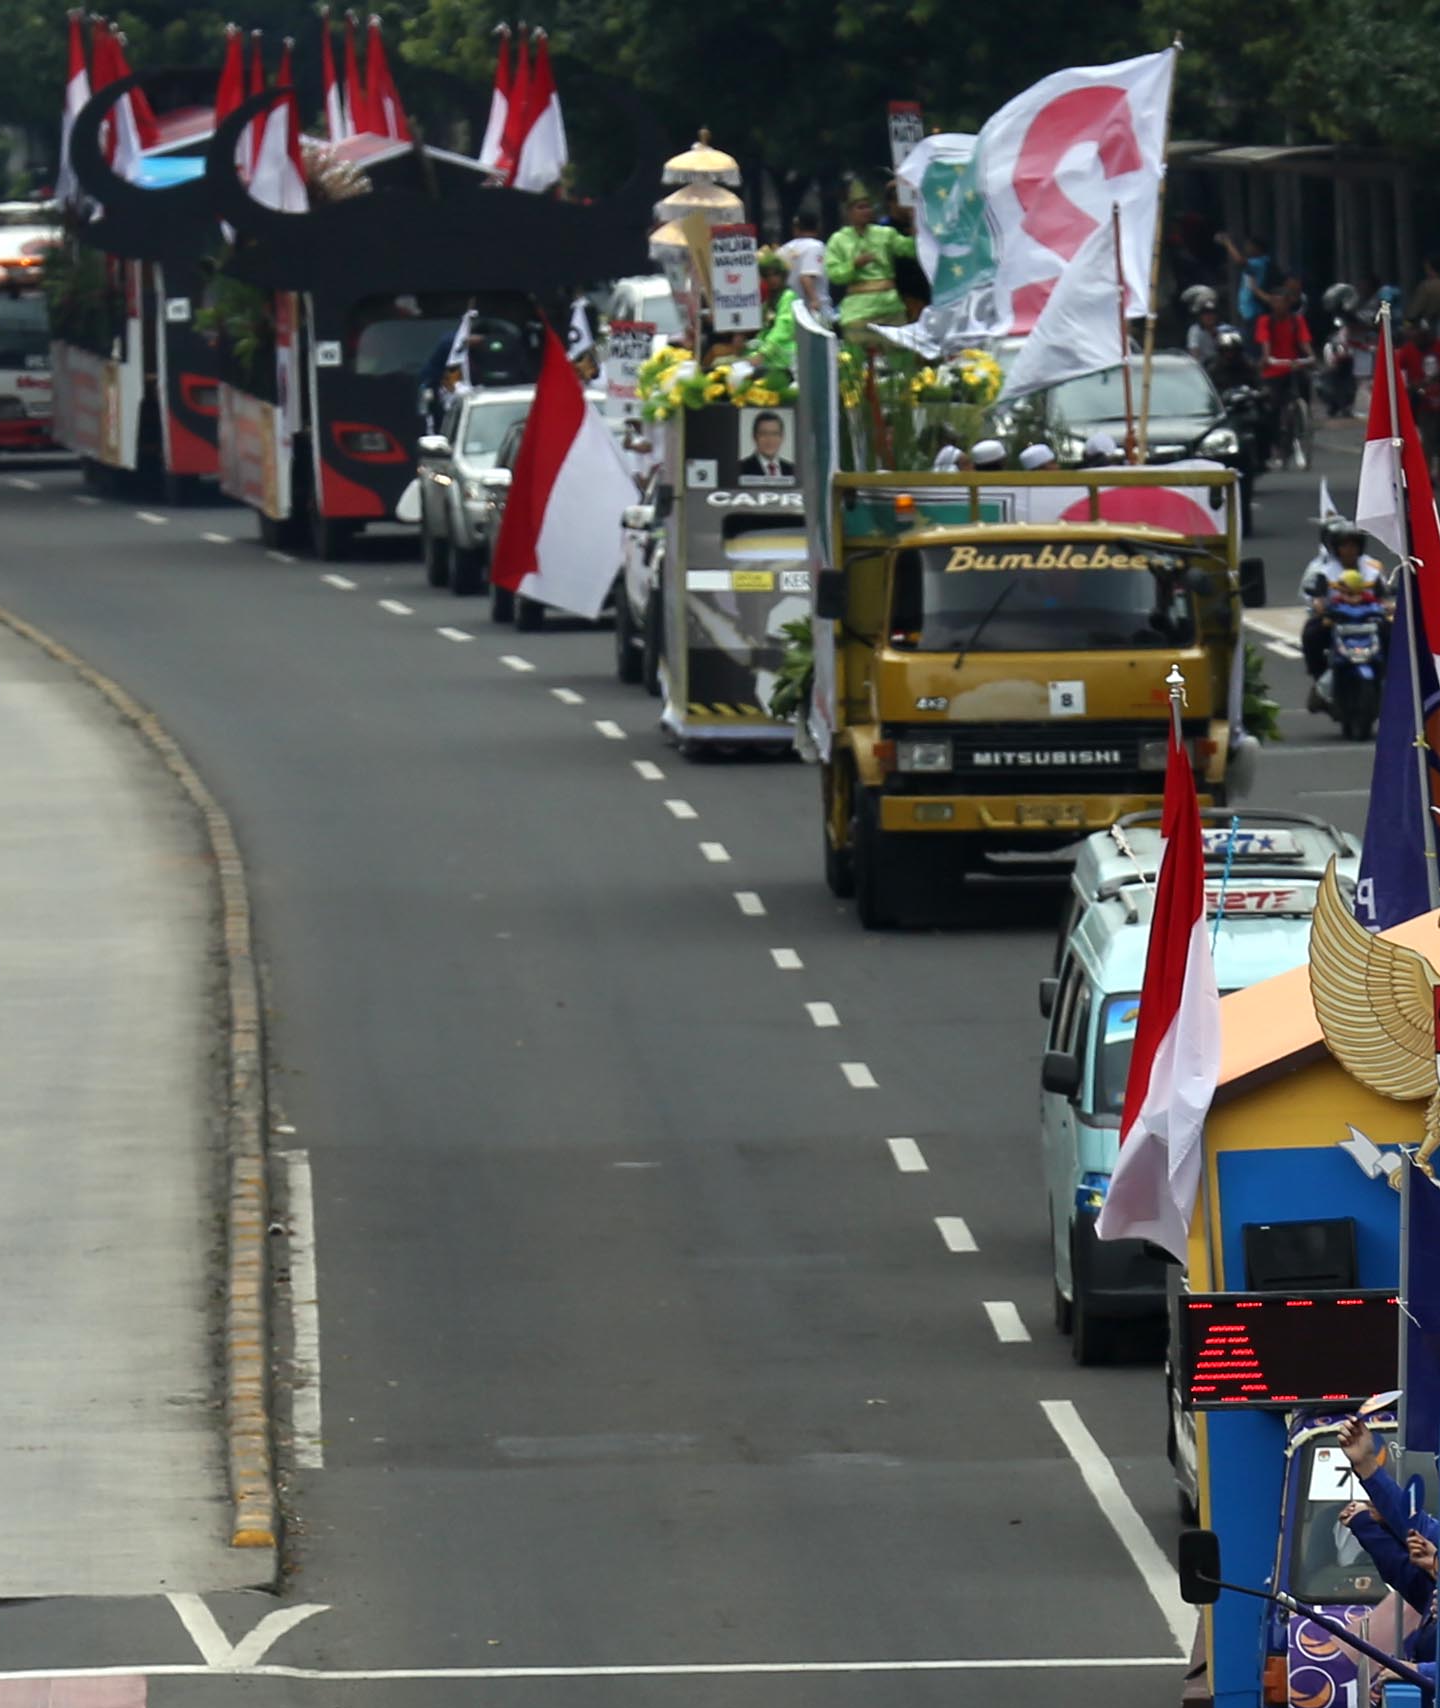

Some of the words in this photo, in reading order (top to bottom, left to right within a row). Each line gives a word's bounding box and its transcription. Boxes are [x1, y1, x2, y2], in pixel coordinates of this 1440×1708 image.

[945, 545, 1149, 572] Bumblebee
[973, 750, 1121, 766] MITSUBISHI
[1215, 833, 1254, 854] 27
[1223, 889, 1270, 909] 27
[1334, 1466, 1353, 1488] 7
